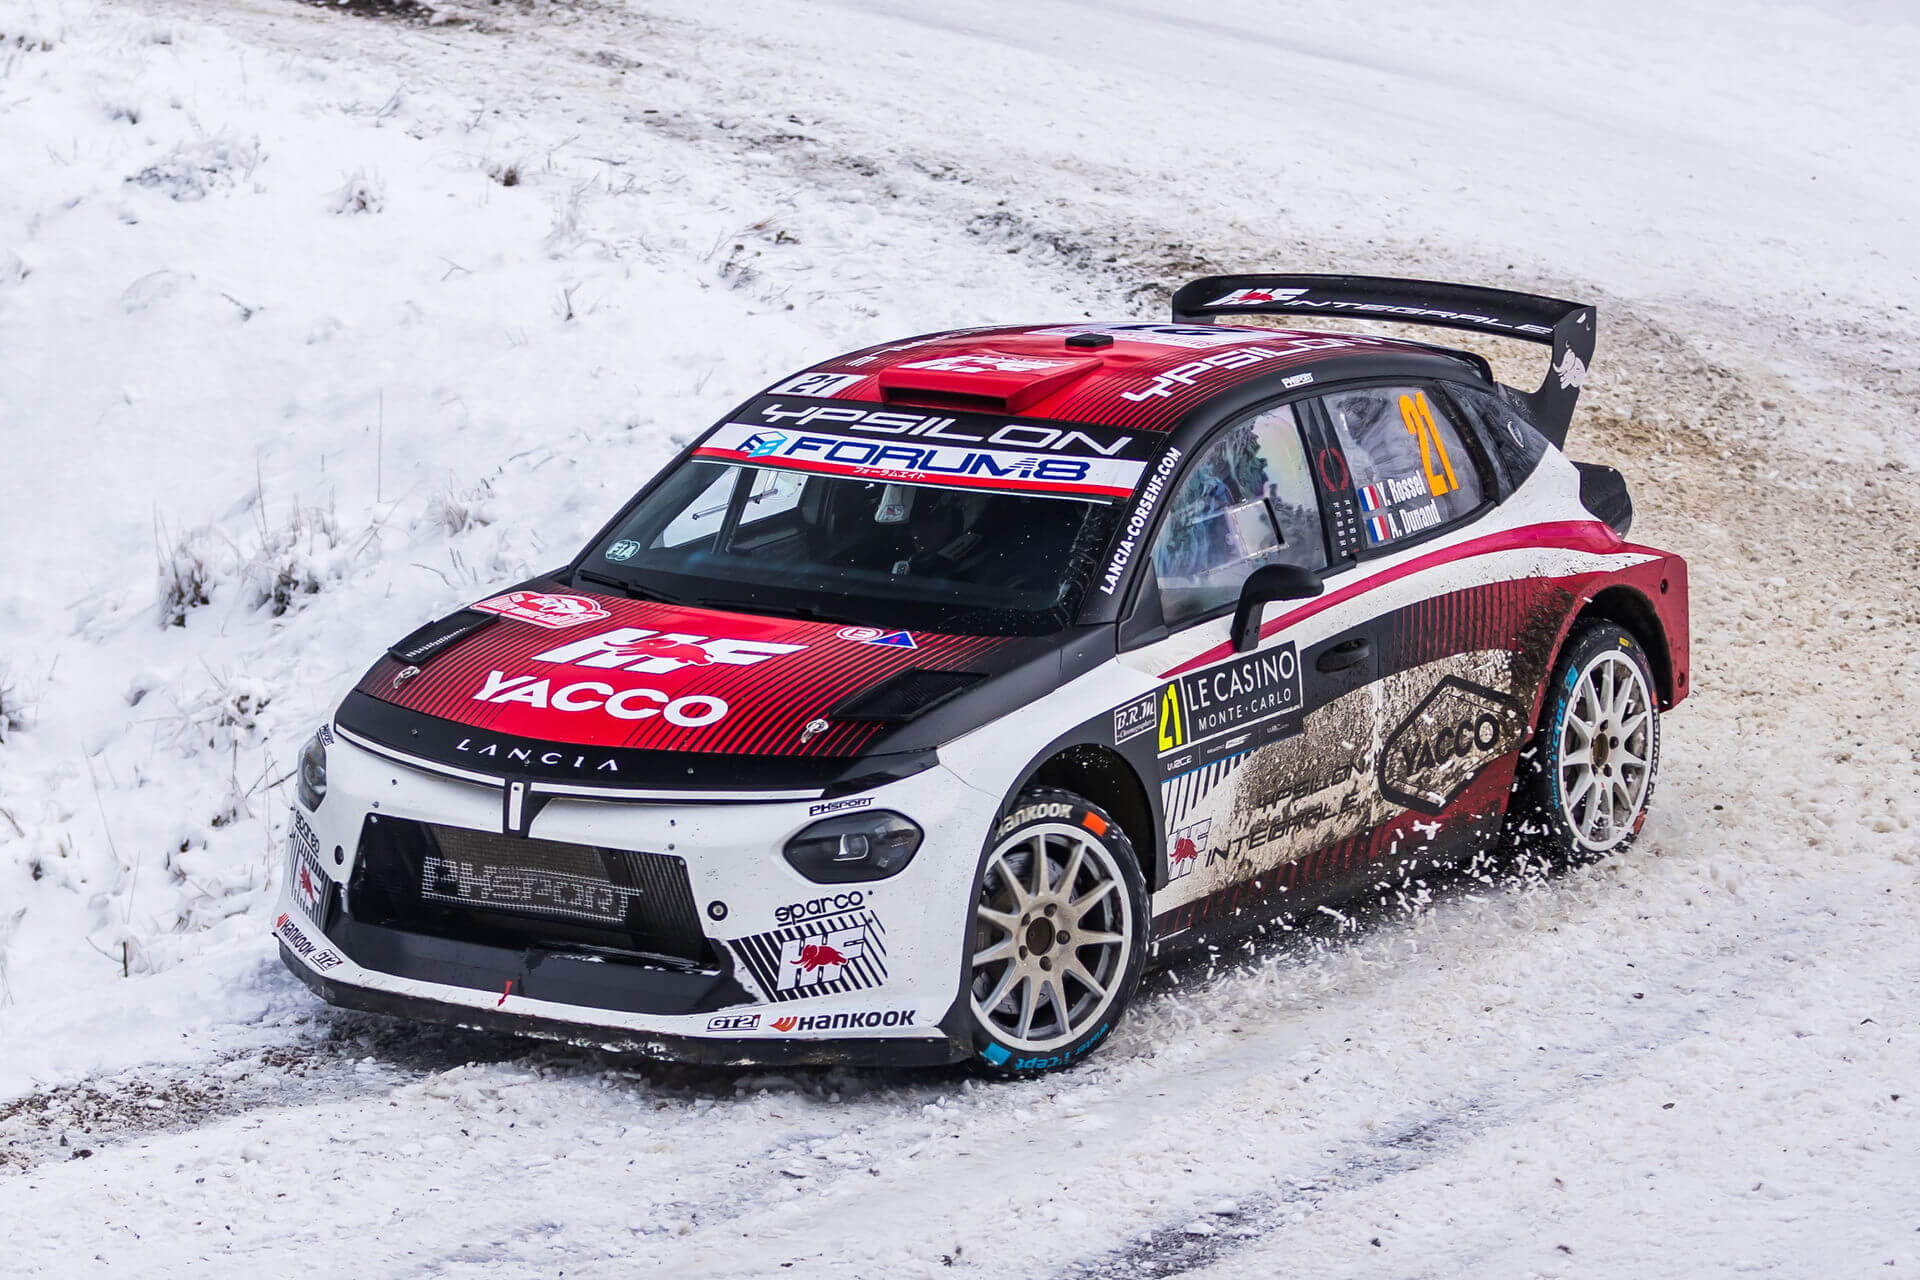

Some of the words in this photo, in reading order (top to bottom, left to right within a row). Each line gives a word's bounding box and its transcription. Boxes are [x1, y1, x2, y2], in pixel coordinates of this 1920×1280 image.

[1282, 300, 1554, 335] INTEGRALE
[786, 374, 849, 395] 21
[760, 403, 1133, 456] YPSILON
[1398, 391, 1460, 497] 21
[784, 435, 1091, 482] FORUM8
[1387, 470, 1427, 505] Rossel
[1099, 446, 1183, 596] LANCIA-CORSEHF.COM
[1387, 513, 1403, 539] A.
[1399, 499, 1442, 535] Dunand
[472, 669, 729, 729] YACCO
[1187, 678, 1211, 711] LE
[1214, 650, 1295, 702] CASINO
[1158, 682, 1183, 752] 21
[456, 738, 619, 773] LANCIA
[1401, 713, 1500, 778] YACCO
[774, 890, 864, 925] sparco
[708, 1014, 760, 1031] GT2i
